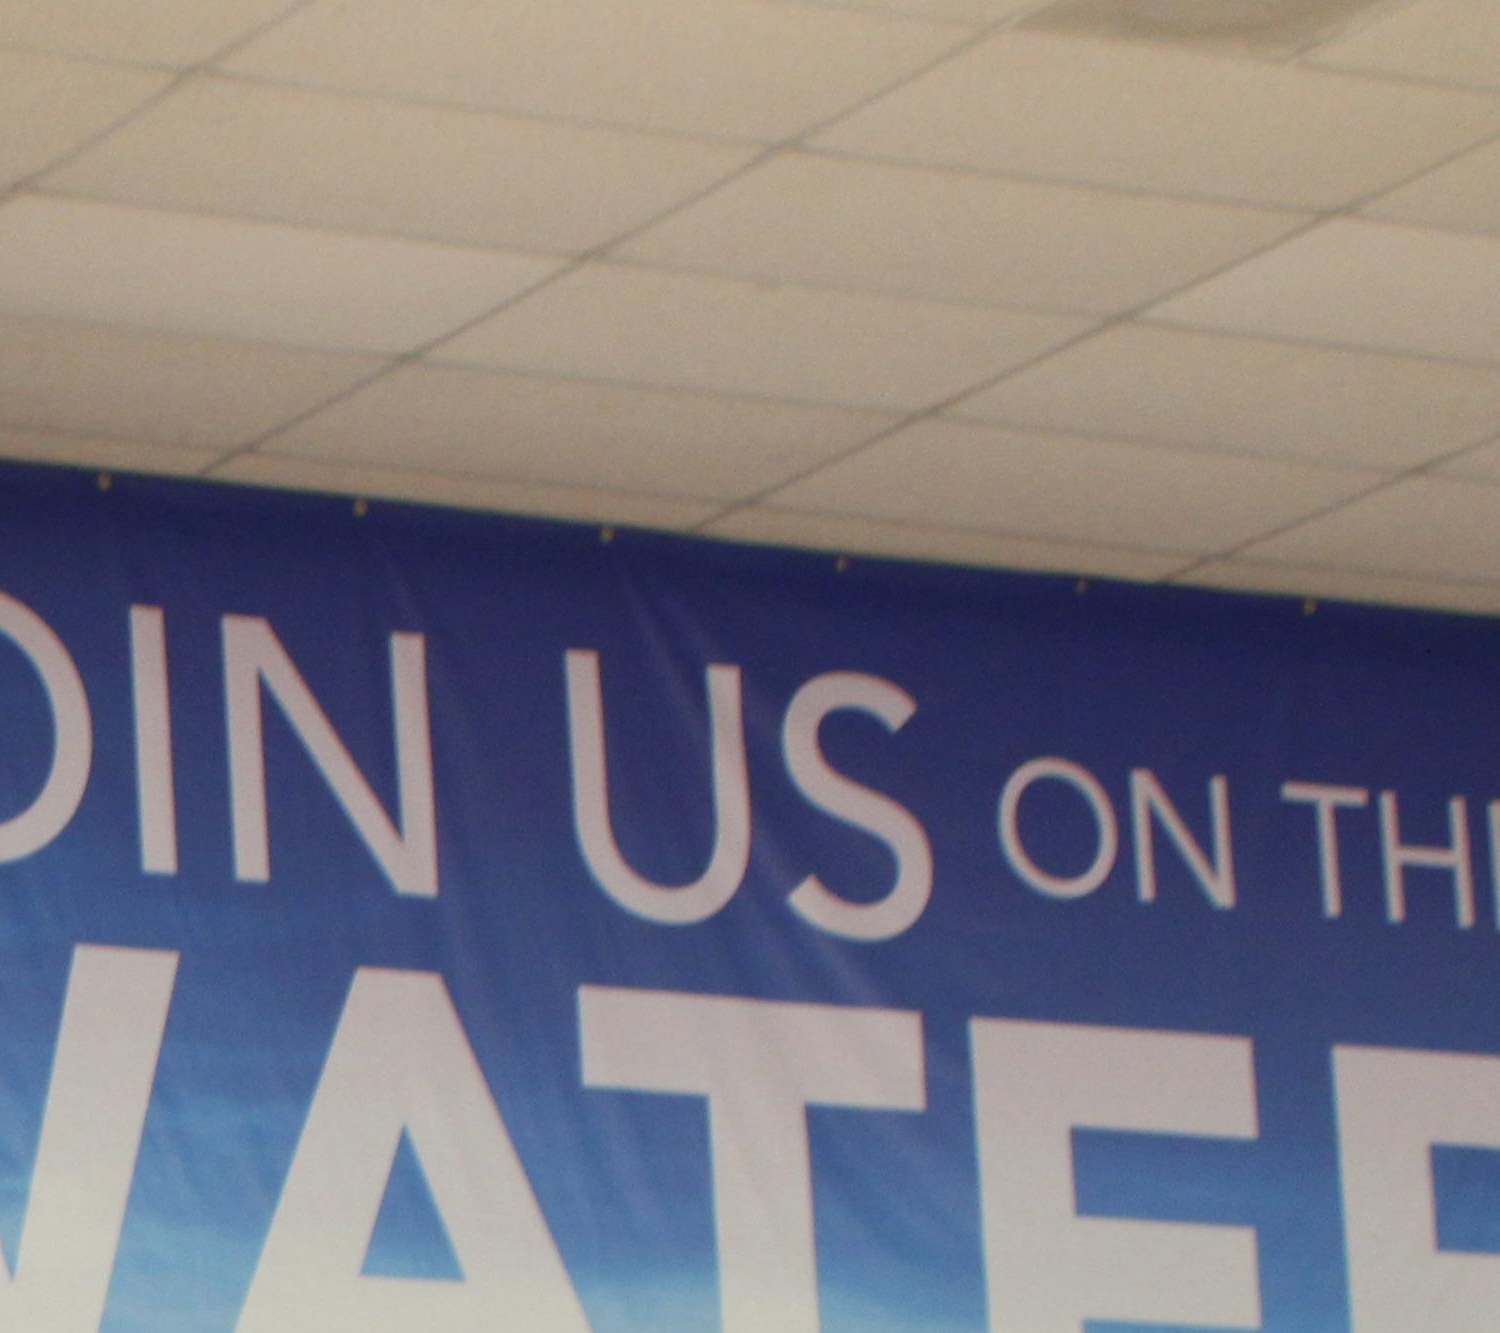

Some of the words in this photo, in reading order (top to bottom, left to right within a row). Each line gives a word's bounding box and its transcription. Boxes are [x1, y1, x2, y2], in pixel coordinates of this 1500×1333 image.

[565, 647, 934, 943] US
[997, 754, 1237, 912] ON
[1280, 780, 1500, 932] TH
